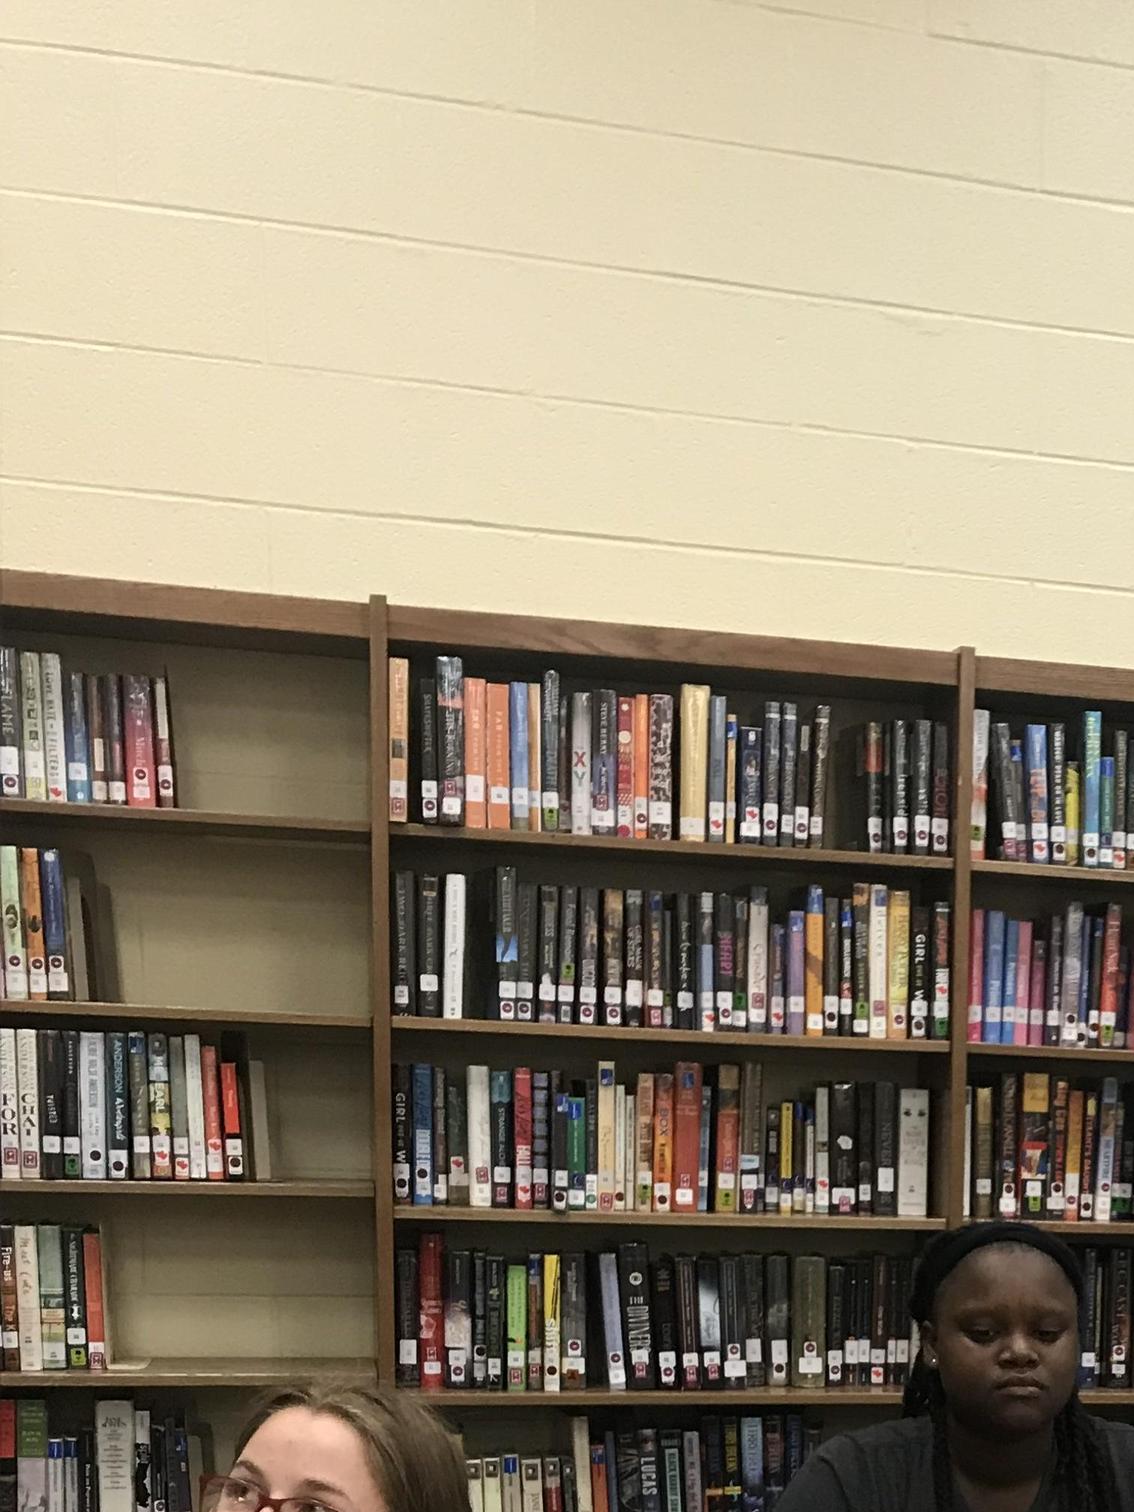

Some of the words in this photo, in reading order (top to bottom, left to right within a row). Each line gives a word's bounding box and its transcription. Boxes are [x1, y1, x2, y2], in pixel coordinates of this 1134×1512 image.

[914, 933, 926, 963] GIRL
[113, 1040, 124, 1094] ANDERSON
[154, 1083, 165, 1113] EARL
[395, 1092, 406, 1123] GIRL
[497, 1107, 506, 1143] STRANGE
[658, 1108, 669, 1136] BOX
[881, 1121, 893, 1166] NEVER
[640, 1456, 657, 1497] LUCAS
[670, 1452, 680, 1474] BLACK
[670, 1475, 680, 1497] RABBIT
[530, 1492, 541, 1512] JANE
